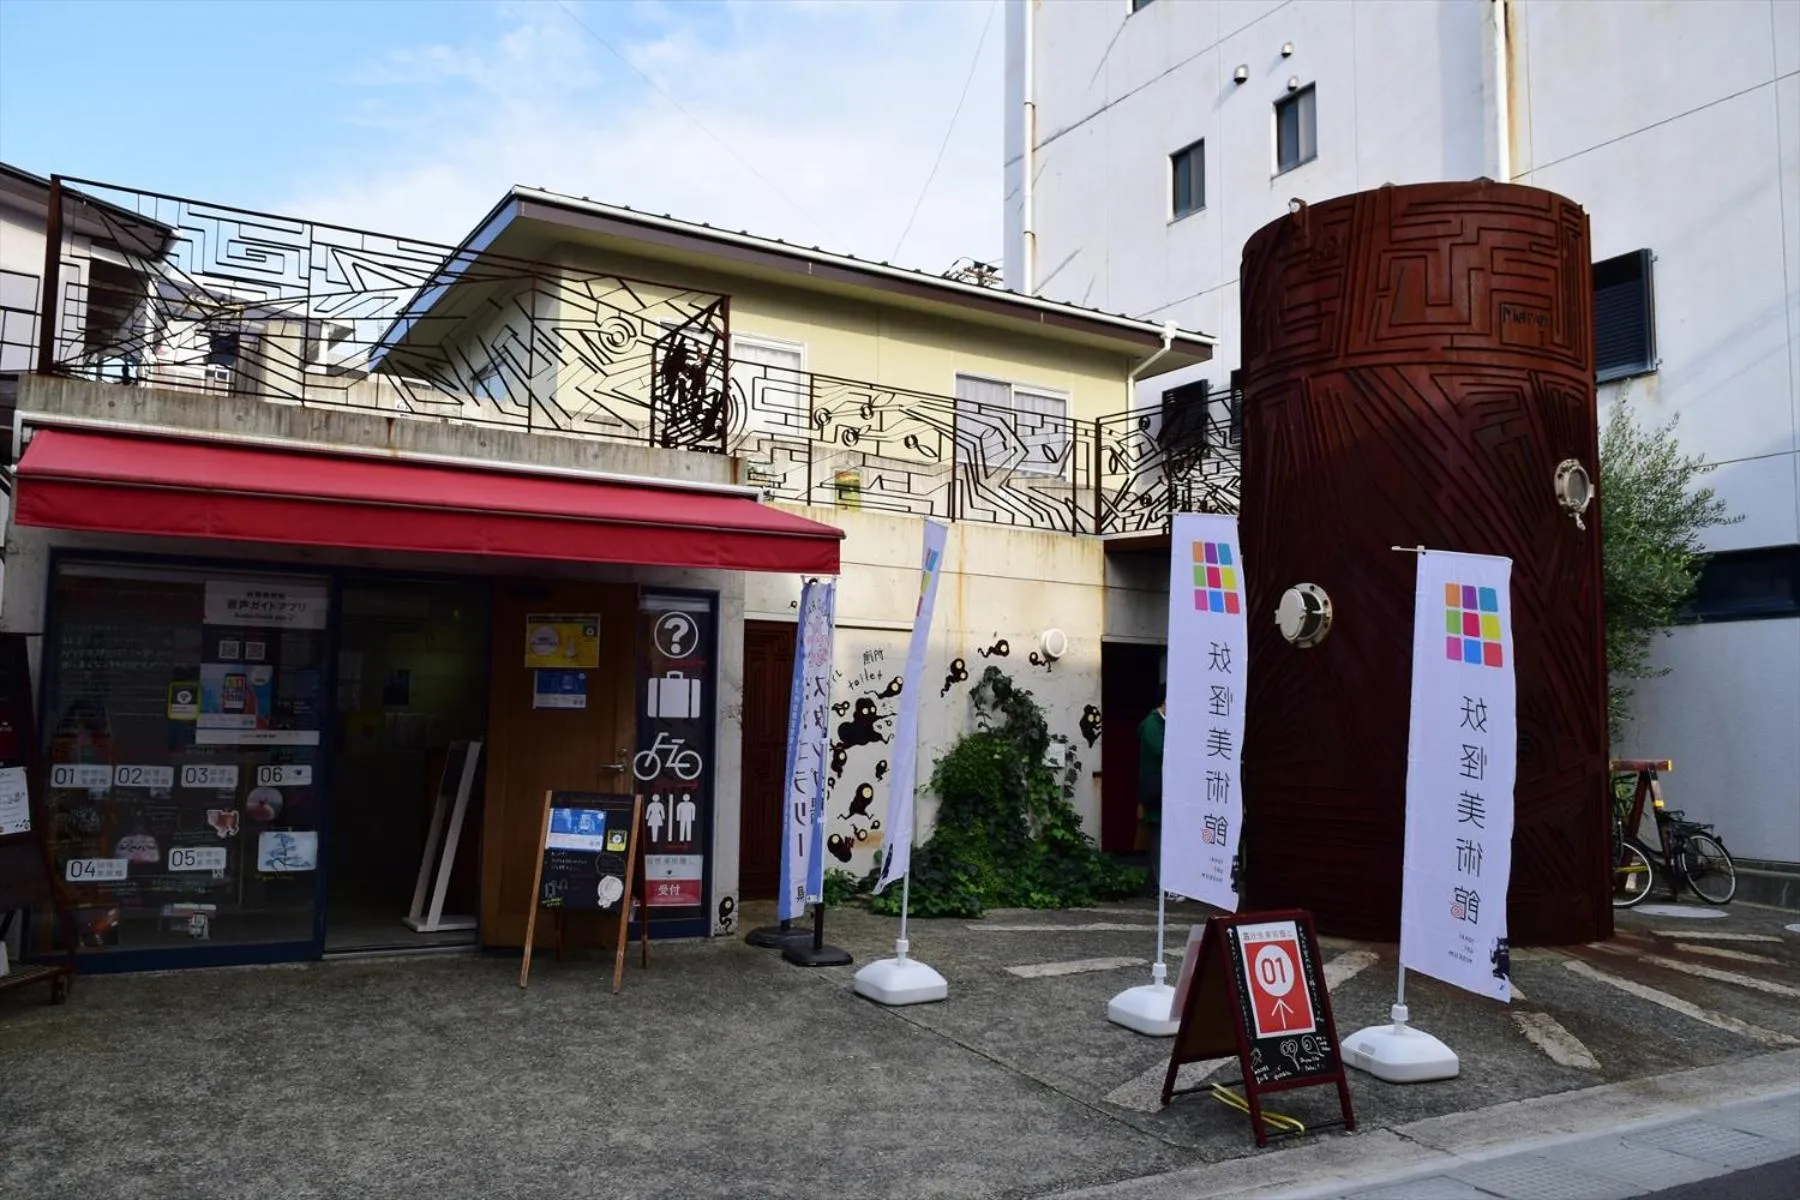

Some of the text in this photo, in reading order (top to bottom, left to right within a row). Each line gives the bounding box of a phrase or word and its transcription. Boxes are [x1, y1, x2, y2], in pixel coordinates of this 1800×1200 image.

[54, 767, 74, 785] 01
[118, 767, 142, 785] 02
[185, 767, 208, 784] 03
[260, 767, 283, 783] 06
[172, 849, 195, 867] 05
[70, 861, 96, 878] 04
[658, 884, 681, 896] 受付
[1261, 957, 1287, 985] 01
